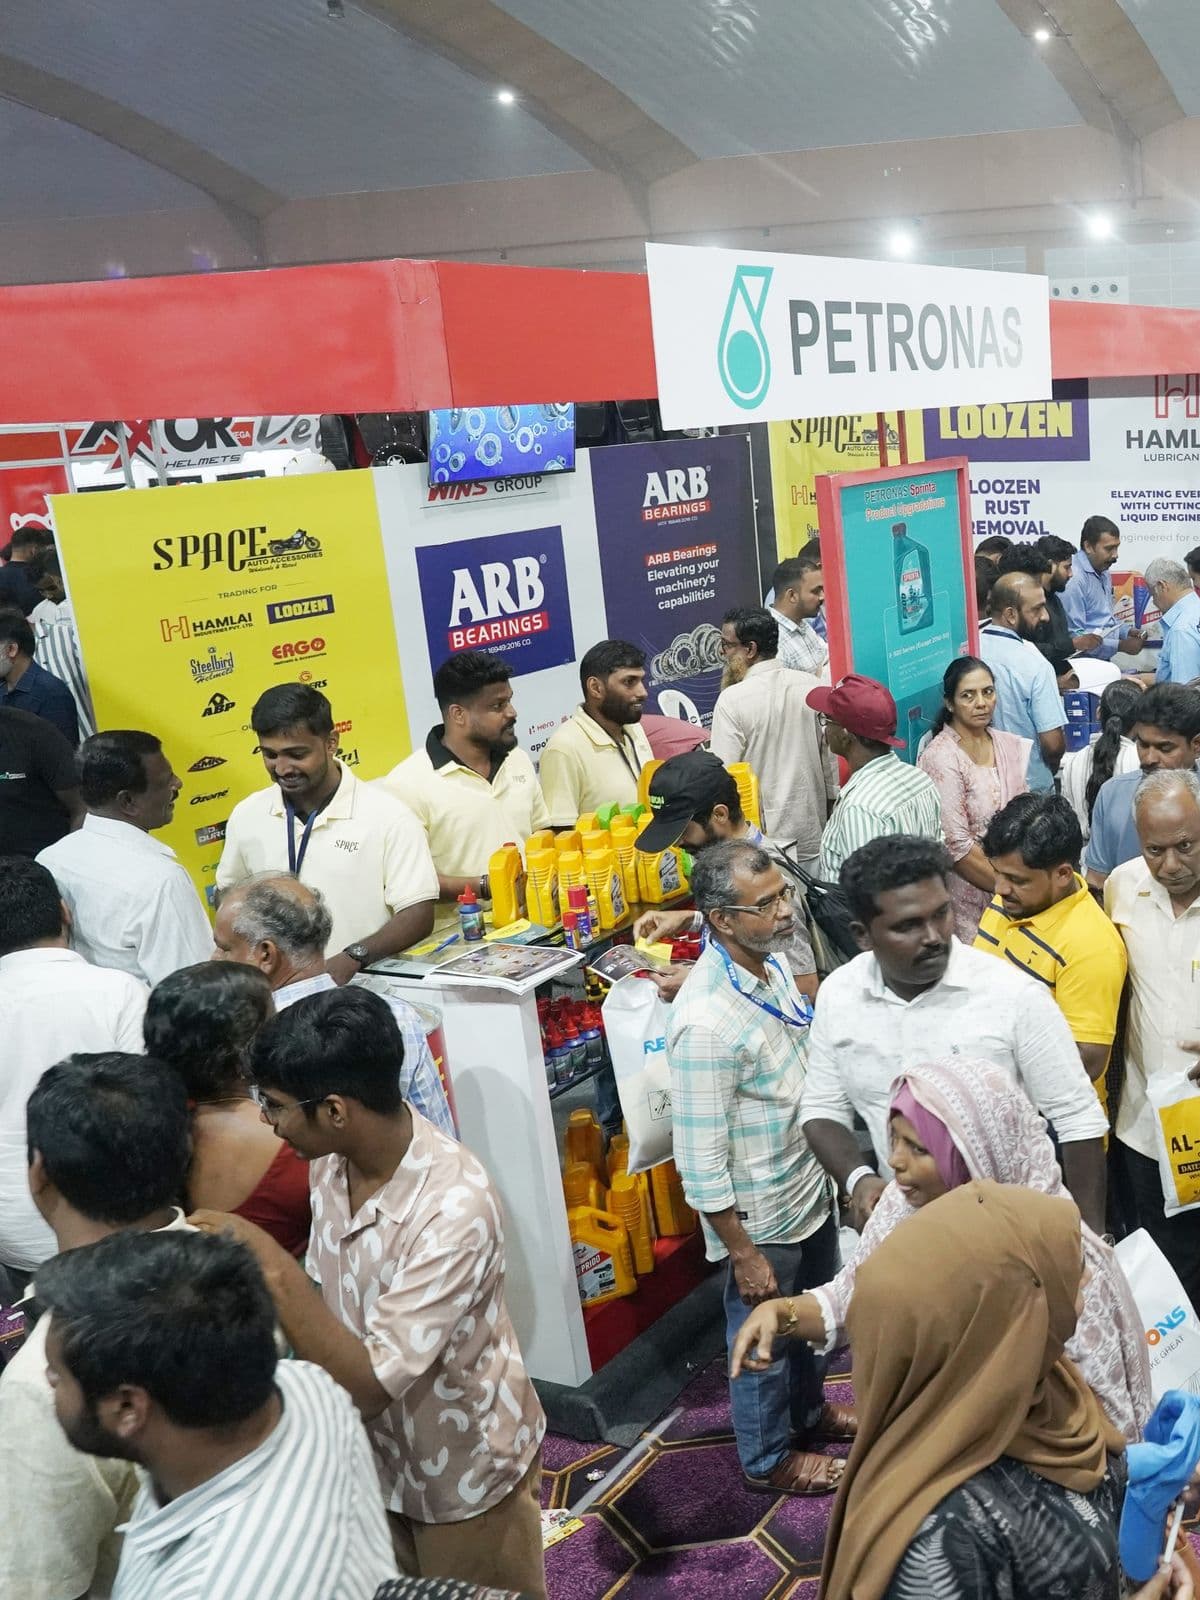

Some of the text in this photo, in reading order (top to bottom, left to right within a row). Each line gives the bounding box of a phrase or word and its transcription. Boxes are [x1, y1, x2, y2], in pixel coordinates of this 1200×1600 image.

[788, 299, 1023, 376] PETRONAS
[939, 402, 1073, 440] LOOZEN
[790, 415, 862, 453] SPACE
[164, 454, 242, 469] HELMETS
[428, 476, 543, 502] WINS GROUP
[642, 466, 709, 508] ARB
[864, 482, 937, 503] PETRONAS Sprinta
[970, 479, 1041, 495] LOOZEN
[1111, 490, 1173, 499] ELEVATING
[645, 501, 707, 520] BEARINGS
[865, 504, 897, 521] Product
[985, 500, 1031, 516] RUST
[1120, 502, 1151, 510] WITH
[1120, 513, 1159, 523] LIQUID
[153, 525, 267, 572] SPACE
[1121, 532, 1173, 545] ngineered
[1176, 532, 1190, 541] for
[247, 551, 323, 567] AUTO ACCESSORIES
[647, 544, 717, 567] ARB Bearings
[647, 559, 720, 582] Elevating your
[217, 584, 278, 600] TRADING FOR
[448, 556, 545, 628] ARB
[655, 574, 716, 596] machinery's
[274, 598, 328, 620] LOOZEN
[658, 588, 716, 610] capabilities
[192, 612, 253, 633] HAMLAI
[452, 613, 543, 649] BEARINGS
[272, 637, 326, 660] ERGO
[190, 652, 234, 675] Steelbird
[193, 667, 234, 684] Helmets
[201, 701, 236, 718] ABP
[190, 790, 229, 806] Ozone
[581, 1254, 601, 1273] PRIDO
[1160, 1335, 1185, 1360] GREAT
